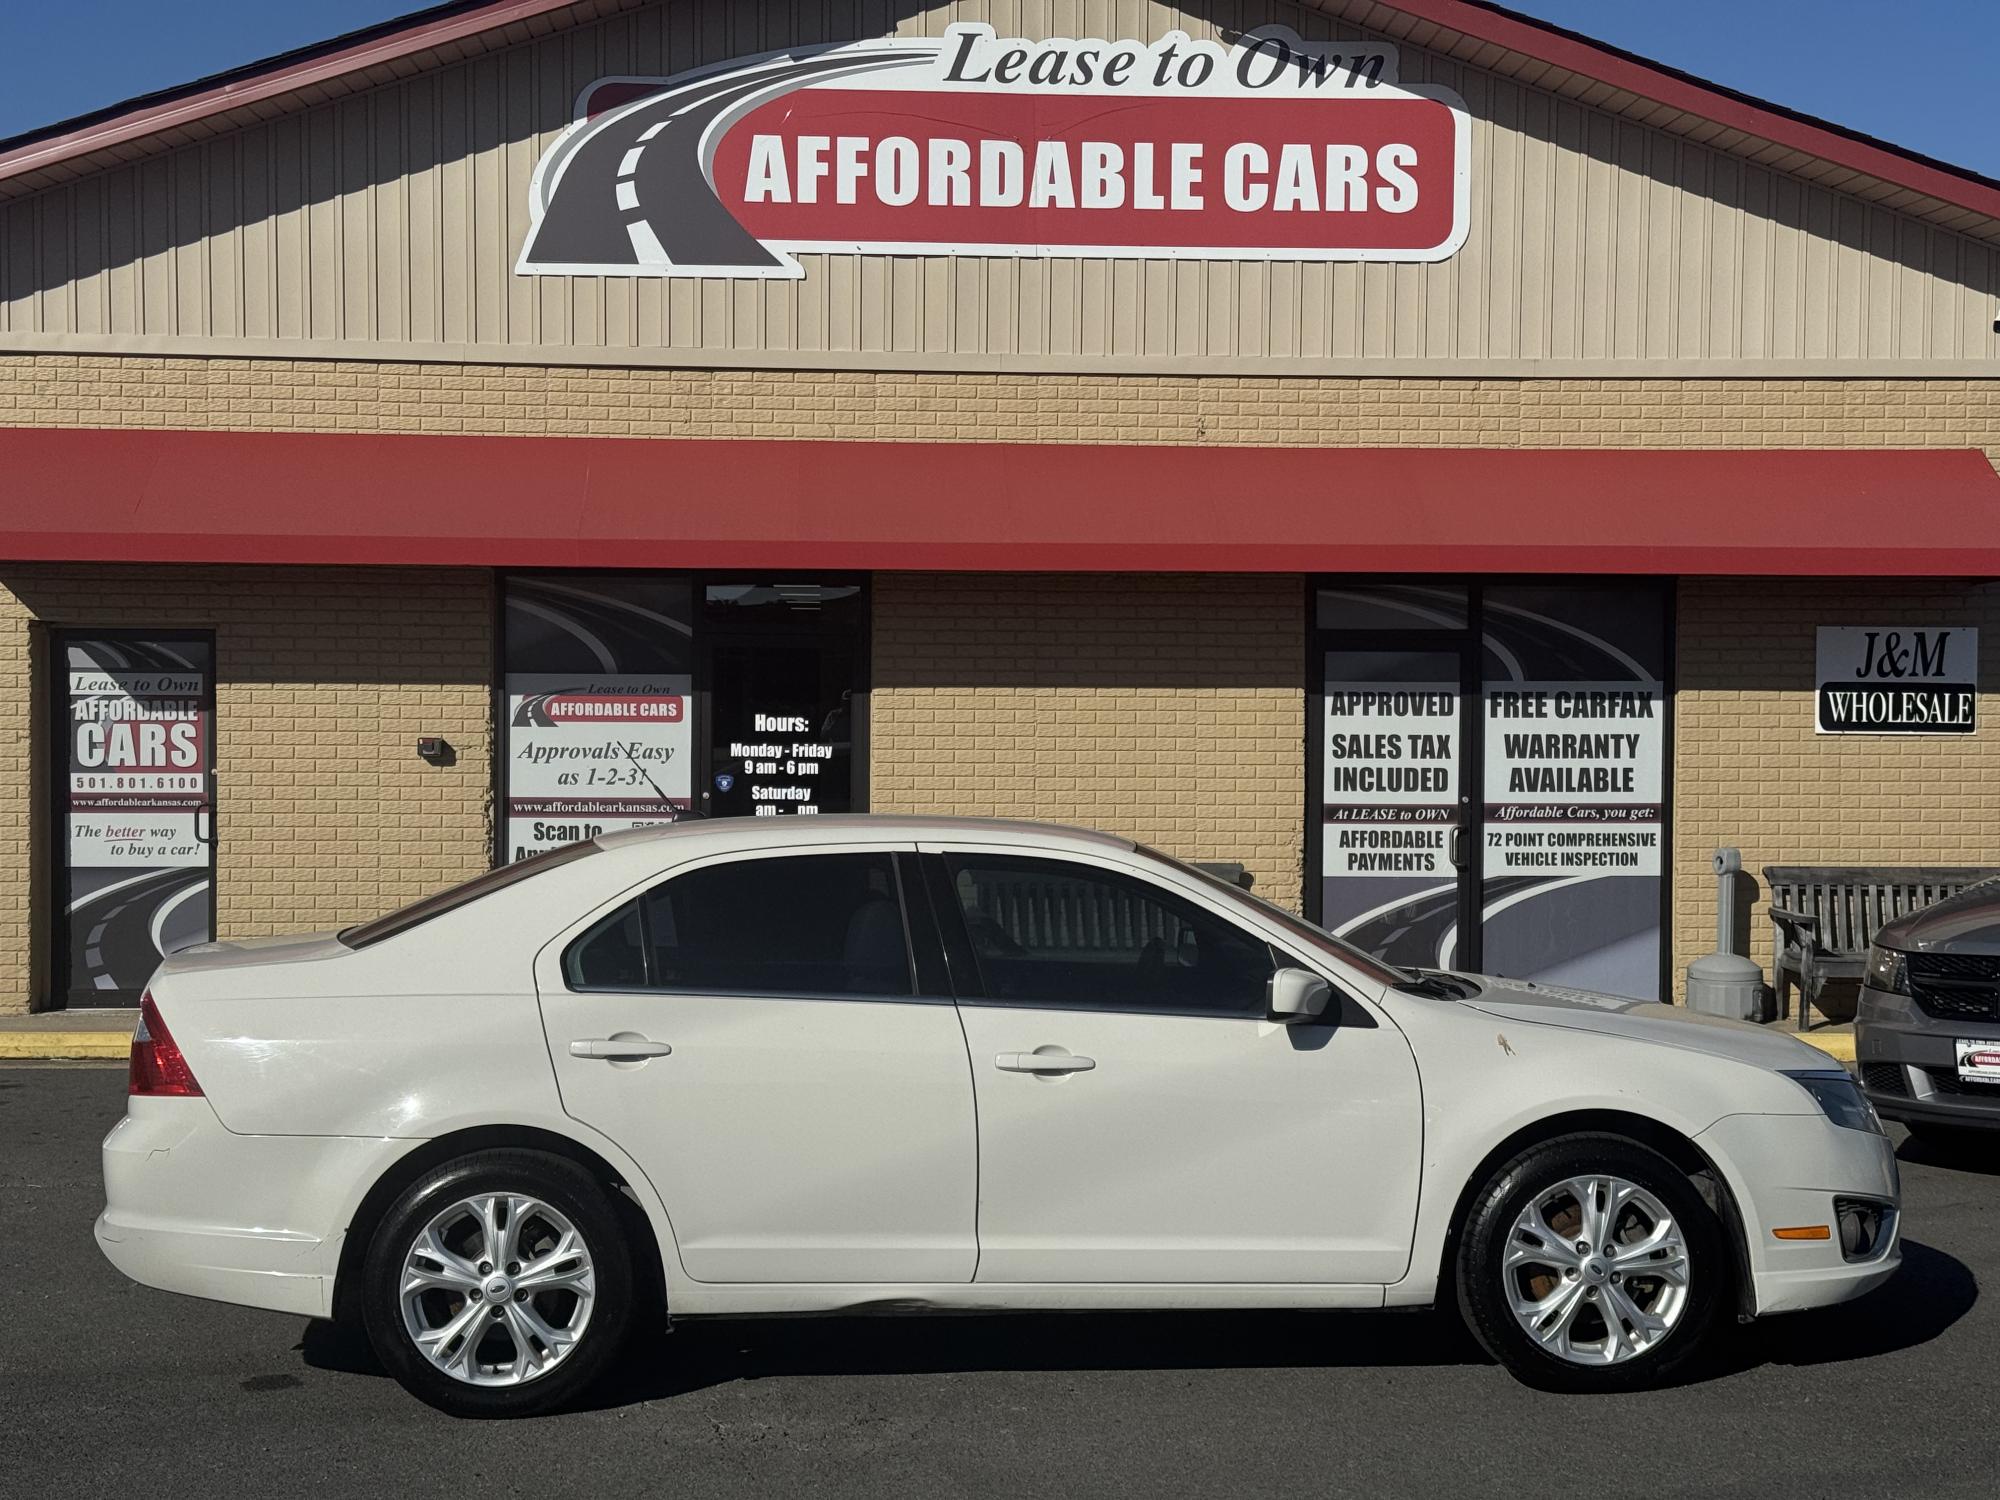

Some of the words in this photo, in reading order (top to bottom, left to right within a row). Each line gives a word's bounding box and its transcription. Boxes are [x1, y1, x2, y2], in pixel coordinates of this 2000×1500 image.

[943, 32, 1136, 86] Lease
[1152, 44, 1214, 87] to
[1237, 37, 1385, 89] Own
[744, 135, 1204, 211] AFFORDABLE
[1224, 142, 1419, 213] CARS
[1856, 632, 1950, 678] J&M
[75, 676, 128, 691] Lease
[133, 680, 150, 691] to
[158, 677, 199, 691] Own
[588, 684, 623, 694] Lease
[627, 685, 638, 694] to
[642, 684, 671, 694] Own
[75, 700, 198, 721] AFFORDABLE
[551, 702, 637, 716] AFFORDABLE
[640, 703, 677, 717] CARS
[1331, 691, 1454, 717] APPROVED
[1490, 691, 1548, 718] FREE
[1554, 691, 1654, 719] CARFAX
[1827, 691, 1972, 724] WHOLESALE
[755, 714, 809, 732] Hours:
[77, 722, 198, 767] CARS
[517, 741, 620, 764] Approvals
[625, 742, 675, 764] Easy
[730, 743, 782, 758] Monday
[792, 743, 832, 759] Friday
[1332, 733, 1402, 760] SALES
[1408, 734, 1451, 760] TAX
[1504, 734, 1640, 759] WARRANTY
[744, 760, 753, 774] 9
[756, 762, 776, 774] am
[786, 760, 795, 774] 6
[798, 762, 819, 776] pm
[76, 777, 198, 788] 501.801.6100
[557, 772, 580, 785] as
[1333, 767, 1449, 792] INCLUDED
[1509, 767, 1635, 793] AVAILABLE
[751, 785, 811, 801] Saturday
[72, 798, 201, 807] www.affordablearkansas.com
[1333, 808, 1348, 820] At
[1351, 808, 1397, 820] LEASE
[1400, 809, 1412, 820] to
[1415, 808, 1450, 820] OWN
[1495, 806, 1564, 820] Affordable
[1567, 806, 1600, 819] Cars,
[1602, 808, 1628, 821] you
[1630, 808, 1655, 820] get:
[75, 825, 102, 838] The
[105, 825, 146, 838] better
[150, 828, 176, 840] way
[533, 822, 580, 841] Scan
[1339, 830, 1443, 848] AFFORDABLE
[1487, 833, 1502, 847] 72
[1505, 832, 1544, 847] POINT
[1547, 832, 1656, 847] COMPREHENSIVE
[110, 844, 124, 856] to
[128, 843, 153, 858] buy
[158, 846, 166, 856] a
[171, 843, 201, 856] car!
[1505, 852, 1558, 866] VEHICLE
[1560, 852, 1639, 867] INSPECTION
[1348, 853, 1435, 871] PAYMENTS
